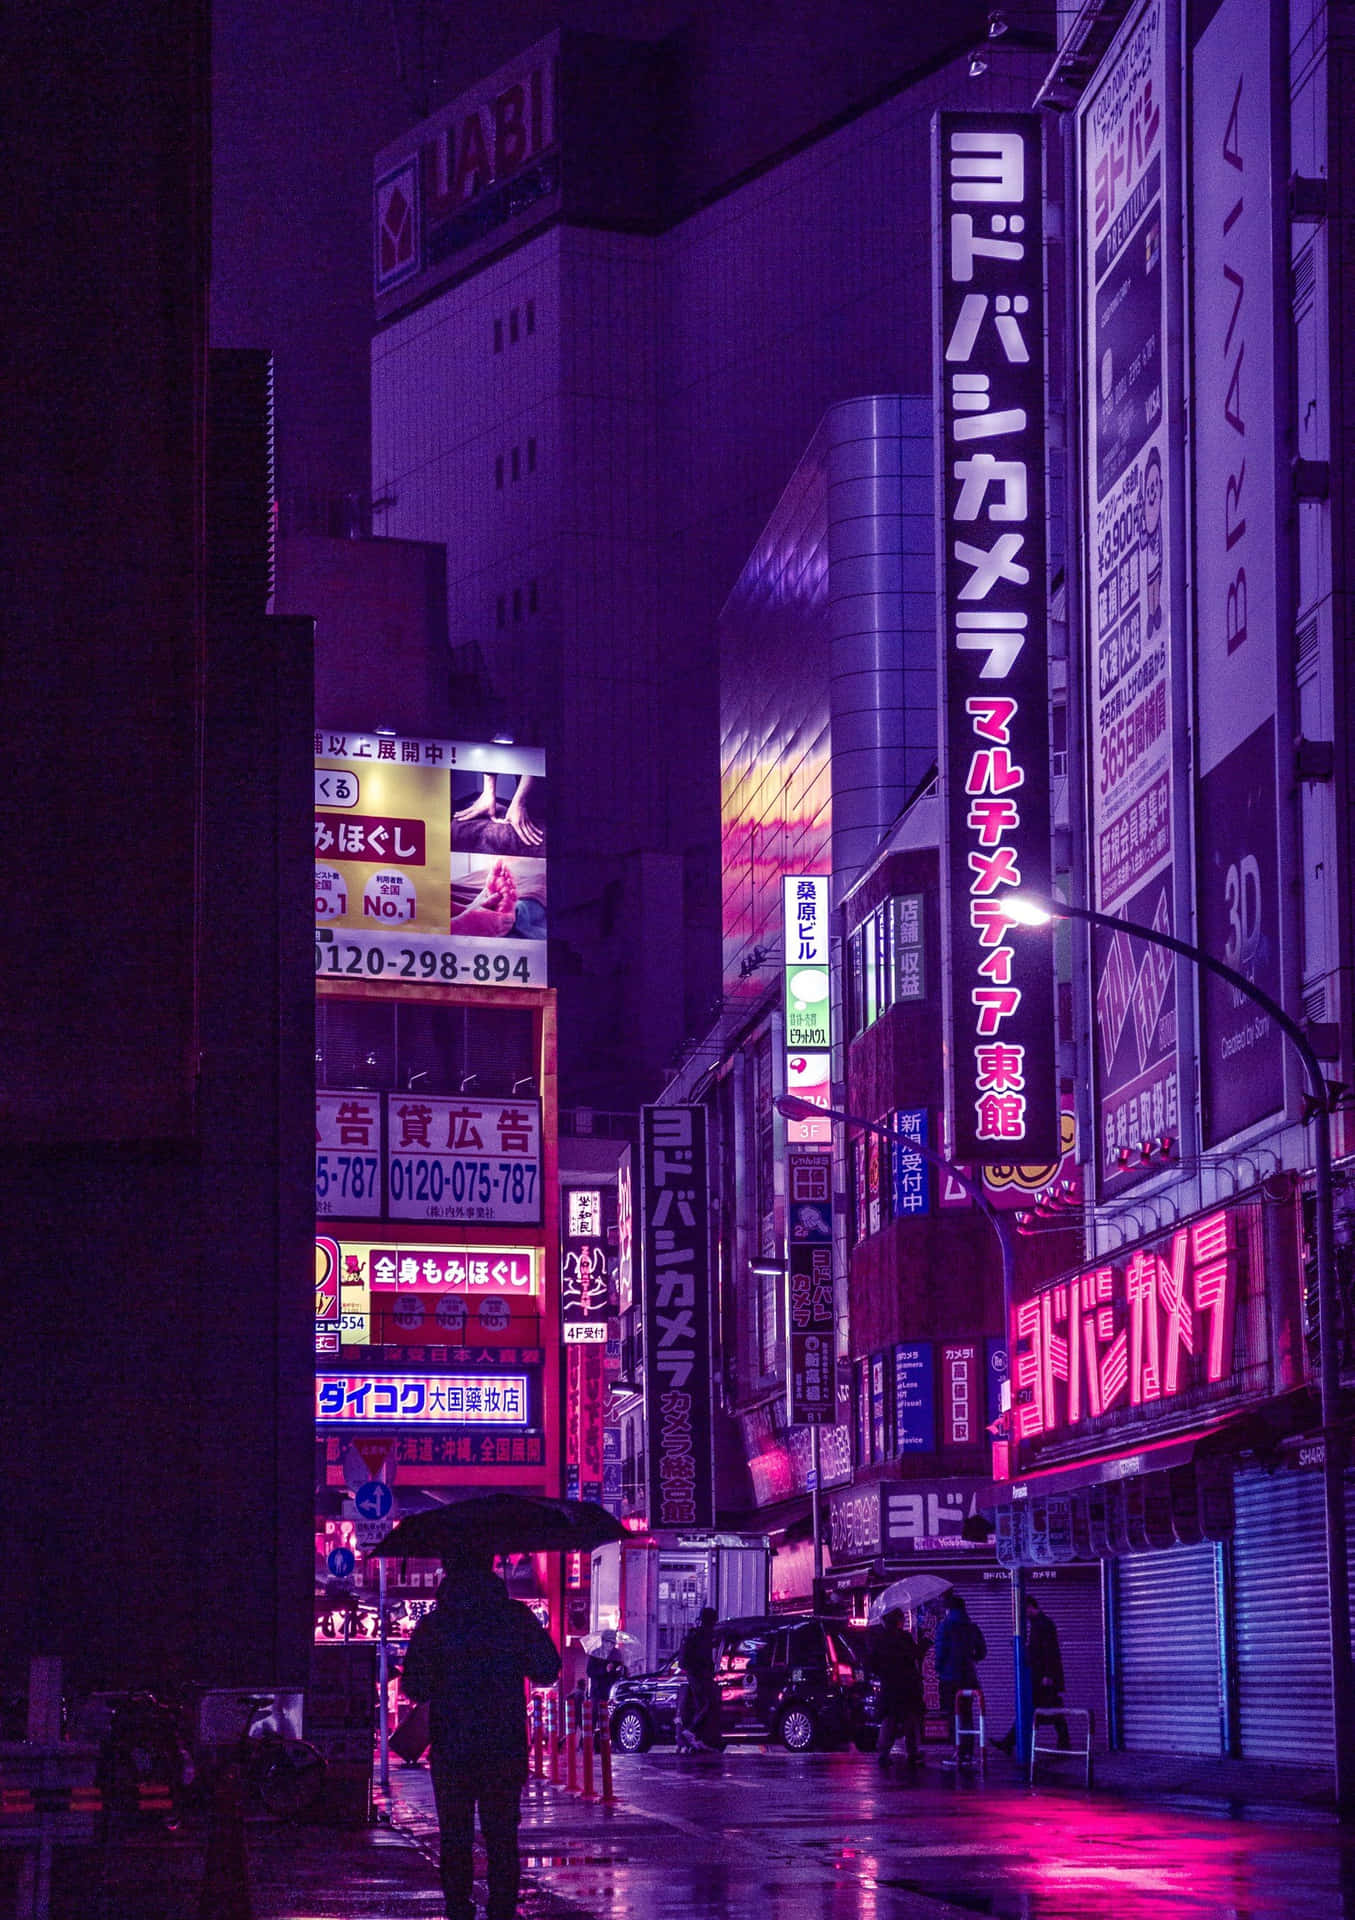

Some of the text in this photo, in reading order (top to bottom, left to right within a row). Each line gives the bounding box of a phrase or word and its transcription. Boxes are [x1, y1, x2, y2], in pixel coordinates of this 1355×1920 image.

[1107, 173, 1148, 264] PREMIUM
[1223, 72, 1248, 657] BRAVIA
[945, 132, 1030, 1142] ヨドバシカメラ マルチメディア東館
[315, 822, 417, 858] みほぐし
[363, 895, 416, 919] No.1
[380, 884, 400, 896] 全国
[796, 880, 817, 961] 桑原ビル
[901, 952, 921, 997] 収益
[397, 1104, 533, 1153] 貸広告
[799, 1124, 821, 1138] 3F
[373, 1255, 529, 1287] 全身もみほぐし
[651, 1110, 697, 1388] ヨドバシカメラ
[791, 1249, 833, 1328] ヨドバシ カメラ
[567, 1326, 605, 1340] 4F受付
[1014, 1208, 1229, 1442] ヨドバシカメラ
[319, 1381, 426, 1415] ダイコク
